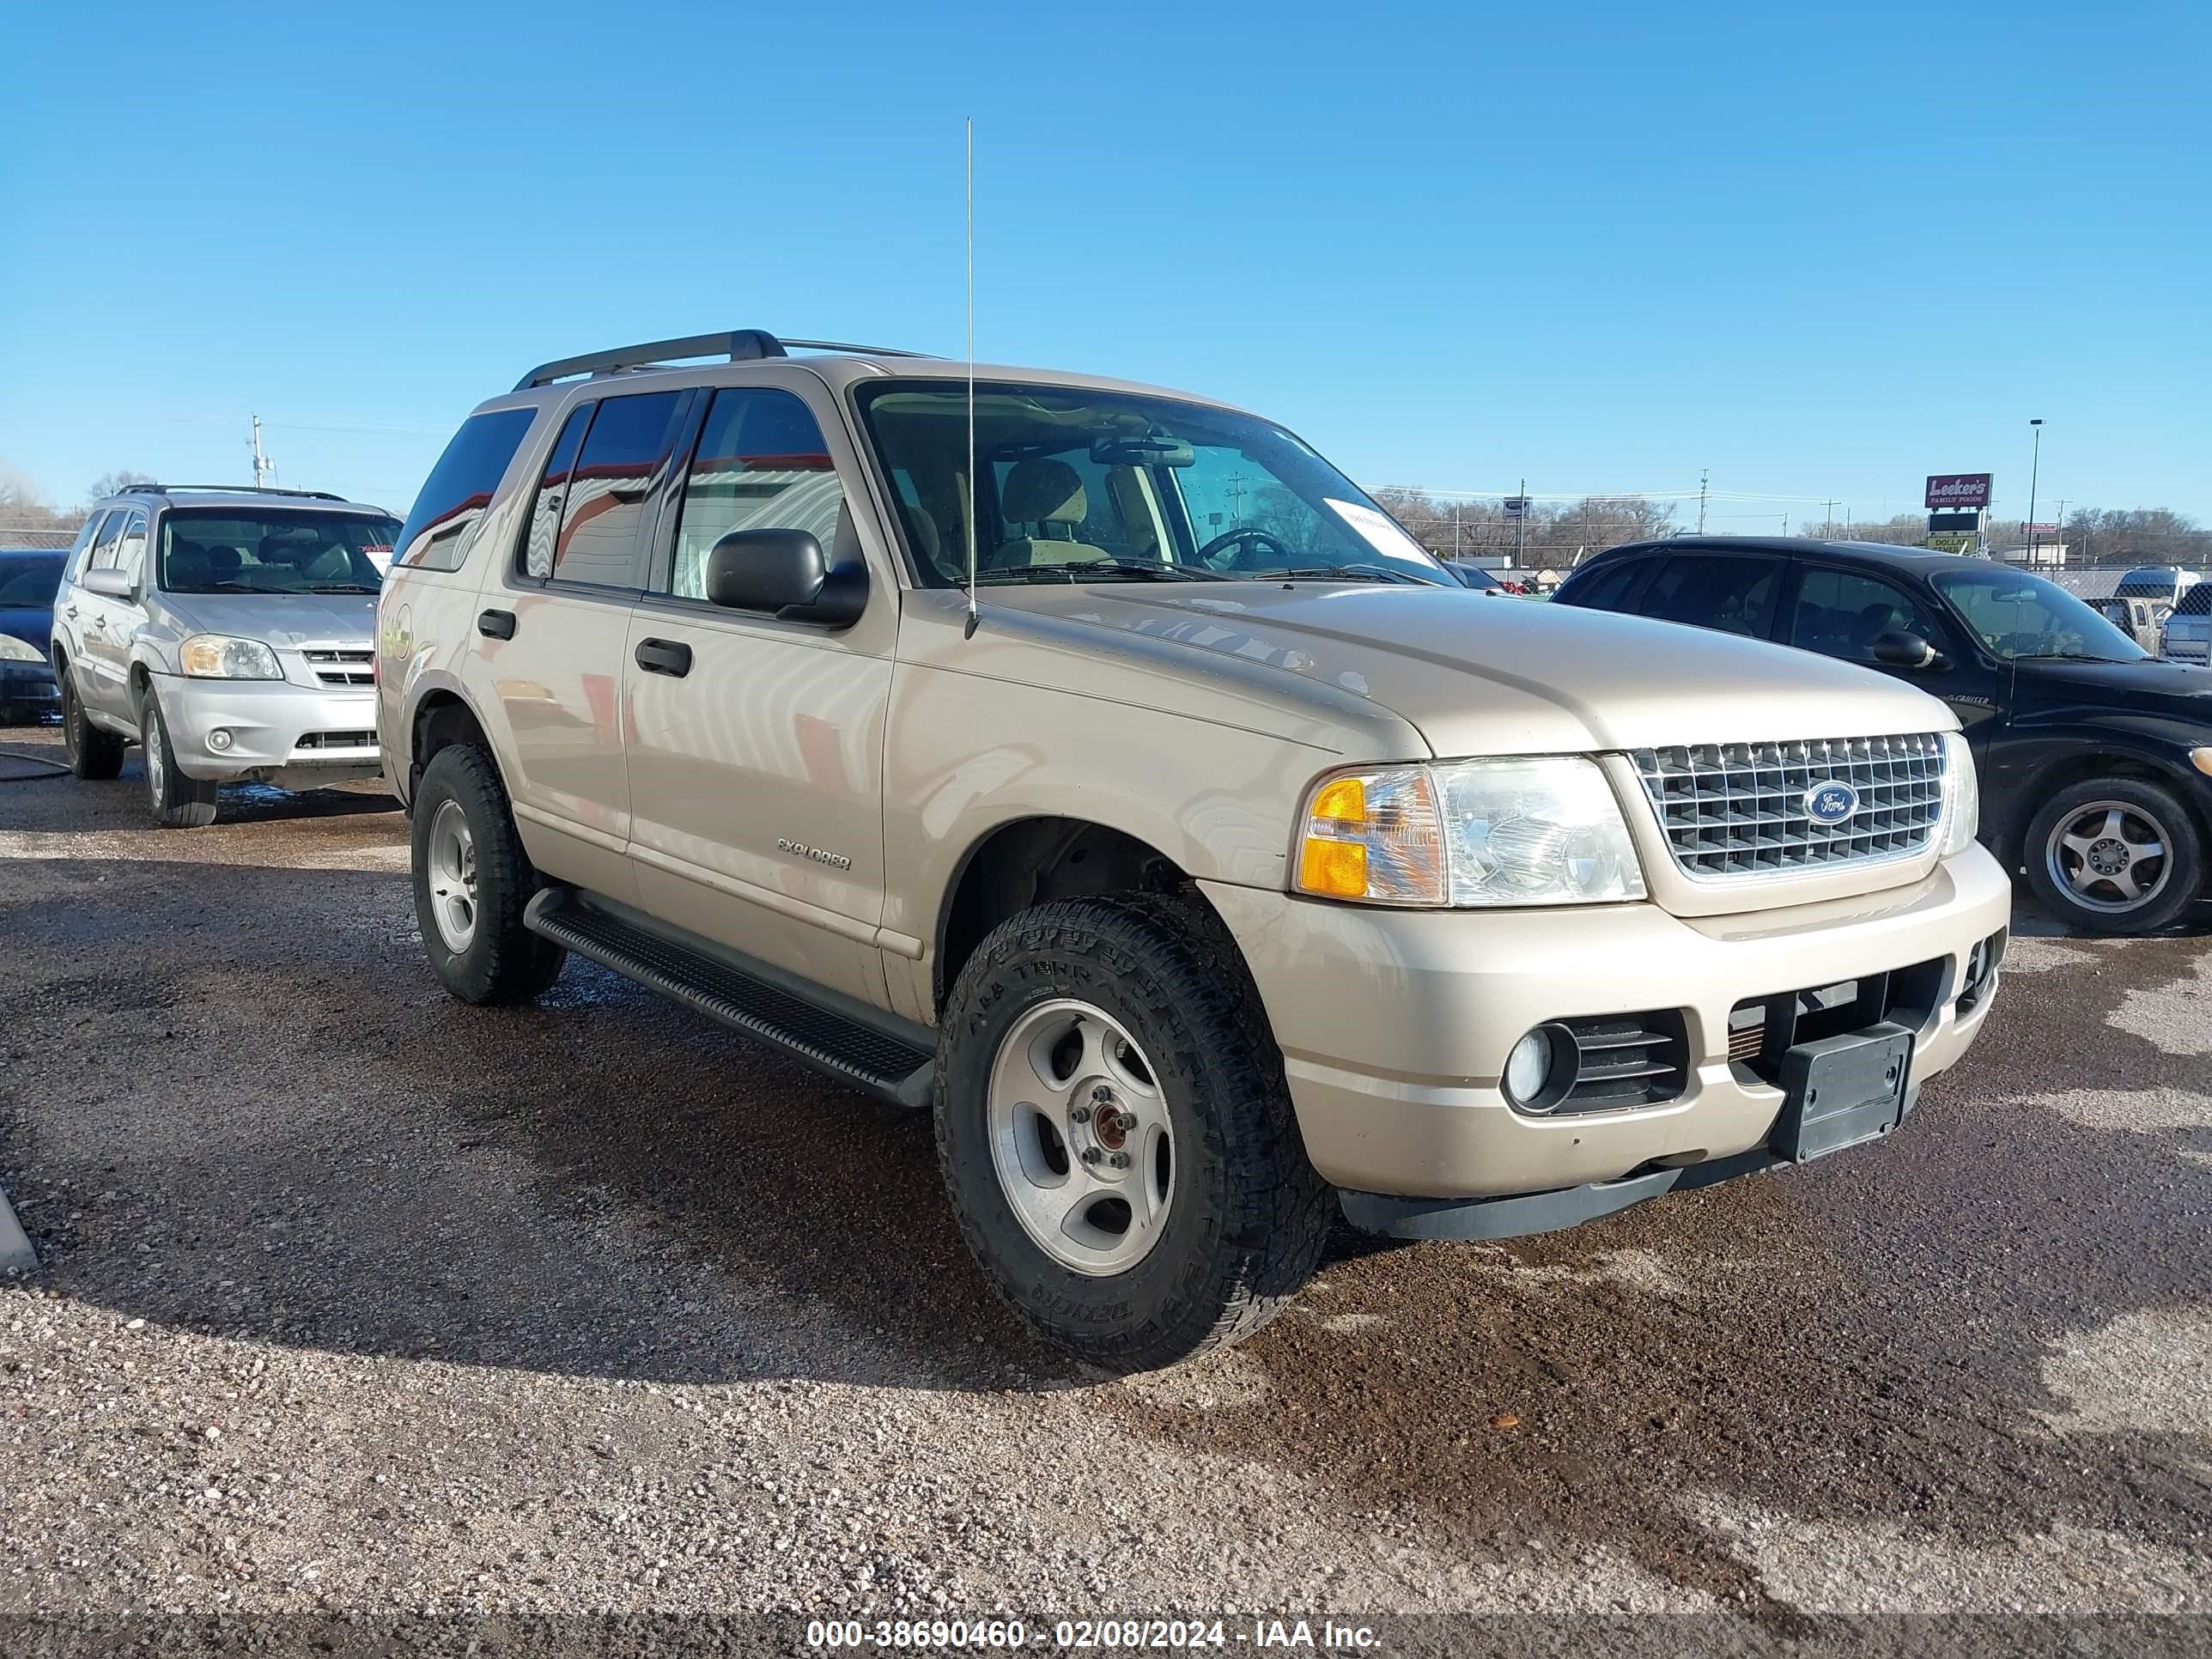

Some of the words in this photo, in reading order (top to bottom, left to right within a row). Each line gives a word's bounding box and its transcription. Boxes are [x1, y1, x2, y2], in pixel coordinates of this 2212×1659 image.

[1929, 478, 1986, 495] Leeker's
[1955, 695, 1990, 704] CRUISER
[1820, 793, 1845, 813] Ford
[777, 836, 852, 871] EXPLORER
